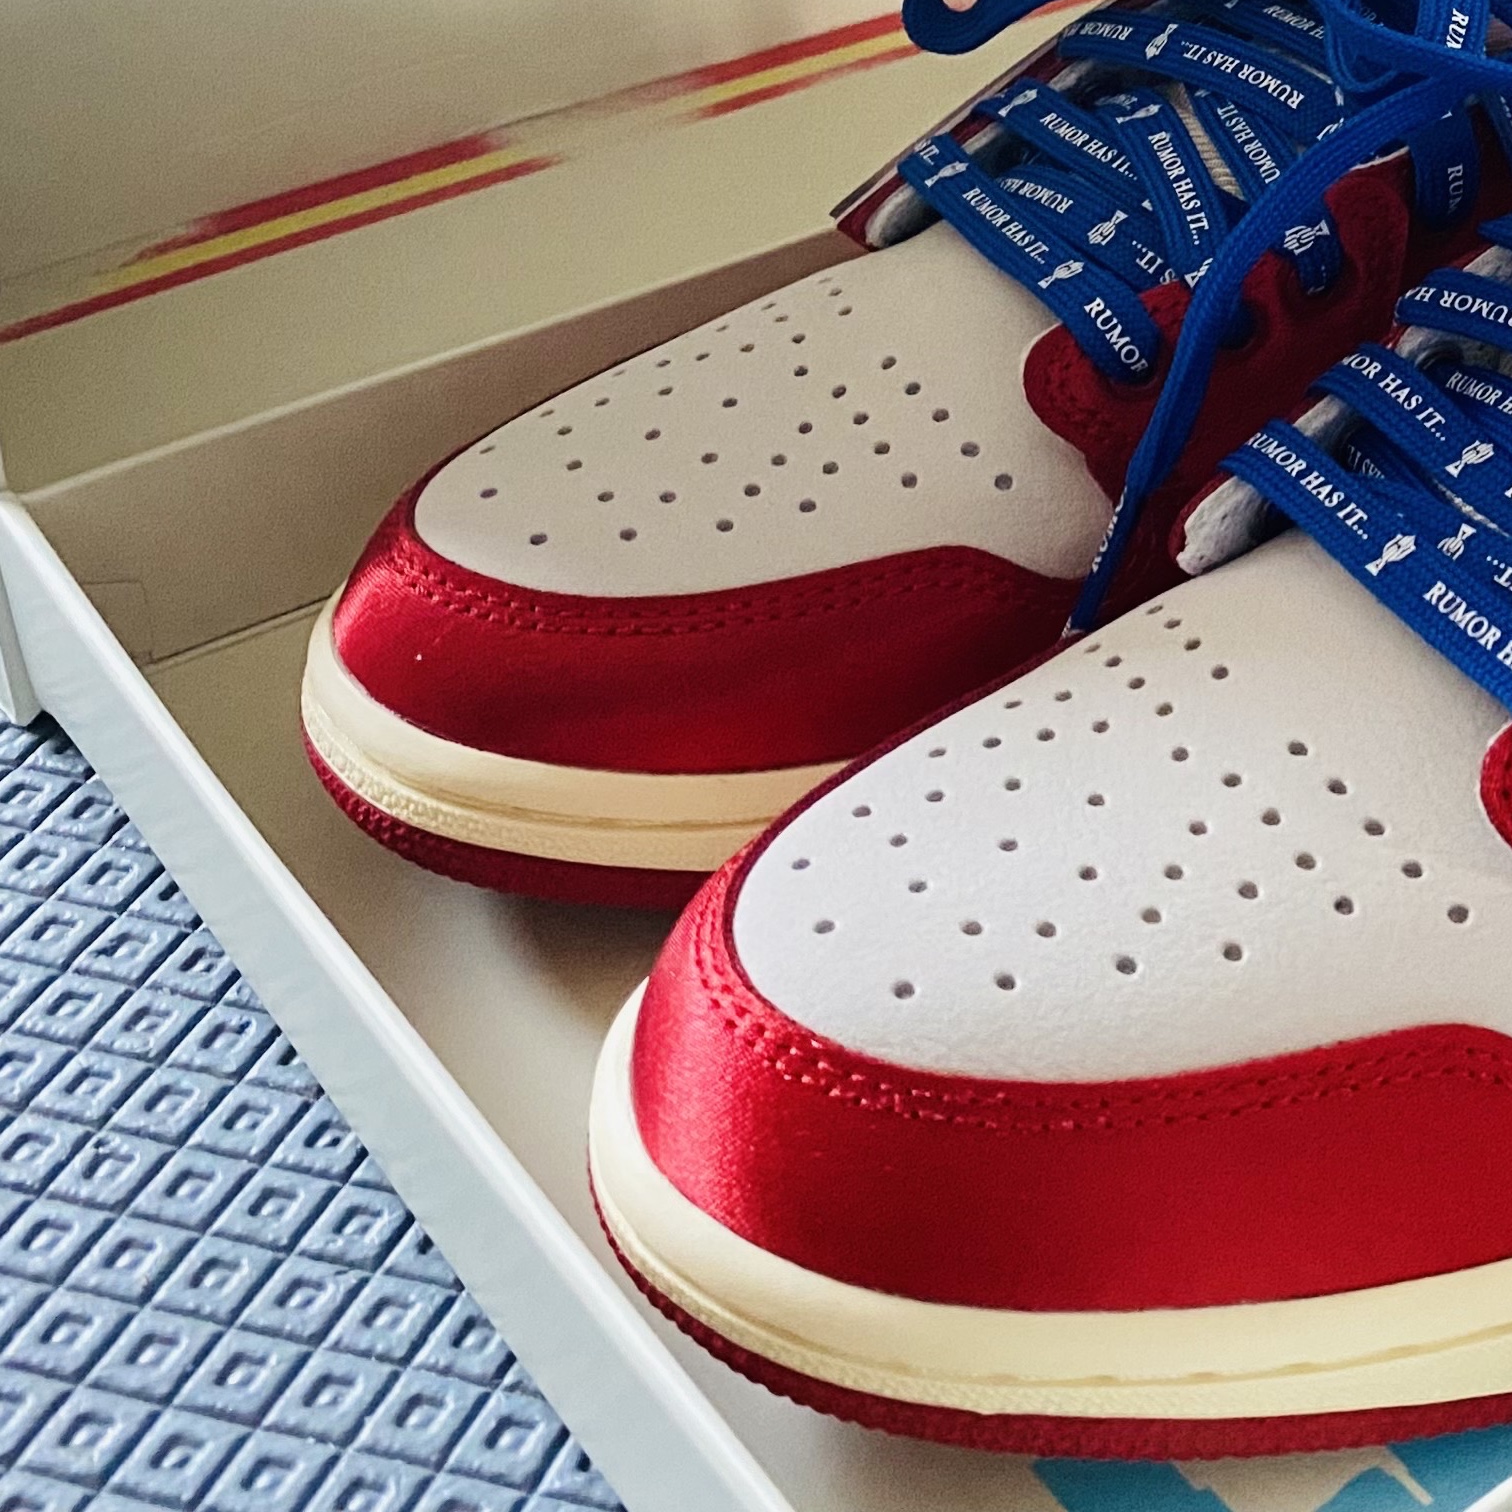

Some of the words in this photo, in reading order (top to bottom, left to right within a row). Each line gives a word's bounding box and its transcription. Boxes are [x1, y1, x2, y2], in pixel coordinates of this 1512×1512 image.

[1262, 5, 1314, 32] RUMOR
[1202, 48, 1241, 74] HAS
[1238, 63, 1306, 110] RUMOR
[1039, 112, 1091, 148] RUMOR
[1082, 139, 1118, 164] HAS
[1224, 115, 1254, 148] HAS
[1147, 131, 1187, 182] RUMOR
[1172, 179, 1202, 212] HAS
[1242, 142, 1282, 184] UMOR
[961, 187, 1010, 229] RUMOR
[1000, 221, 1034, 253] HAS
[1018, 180, 1074, 215] RUMOR
[1083, 296, 1149, 373] RUMOR
[1378, 372, 1424, 412] HAS
[1415, 406, 1447, 443] IT...
[1445, 369, 1503, 404] RUMOR
[1299, 470, 1346, 509] HAS
[1336, 501, 1370, 542] IT...
[1422, 580, 1503, 651] RUMOR
